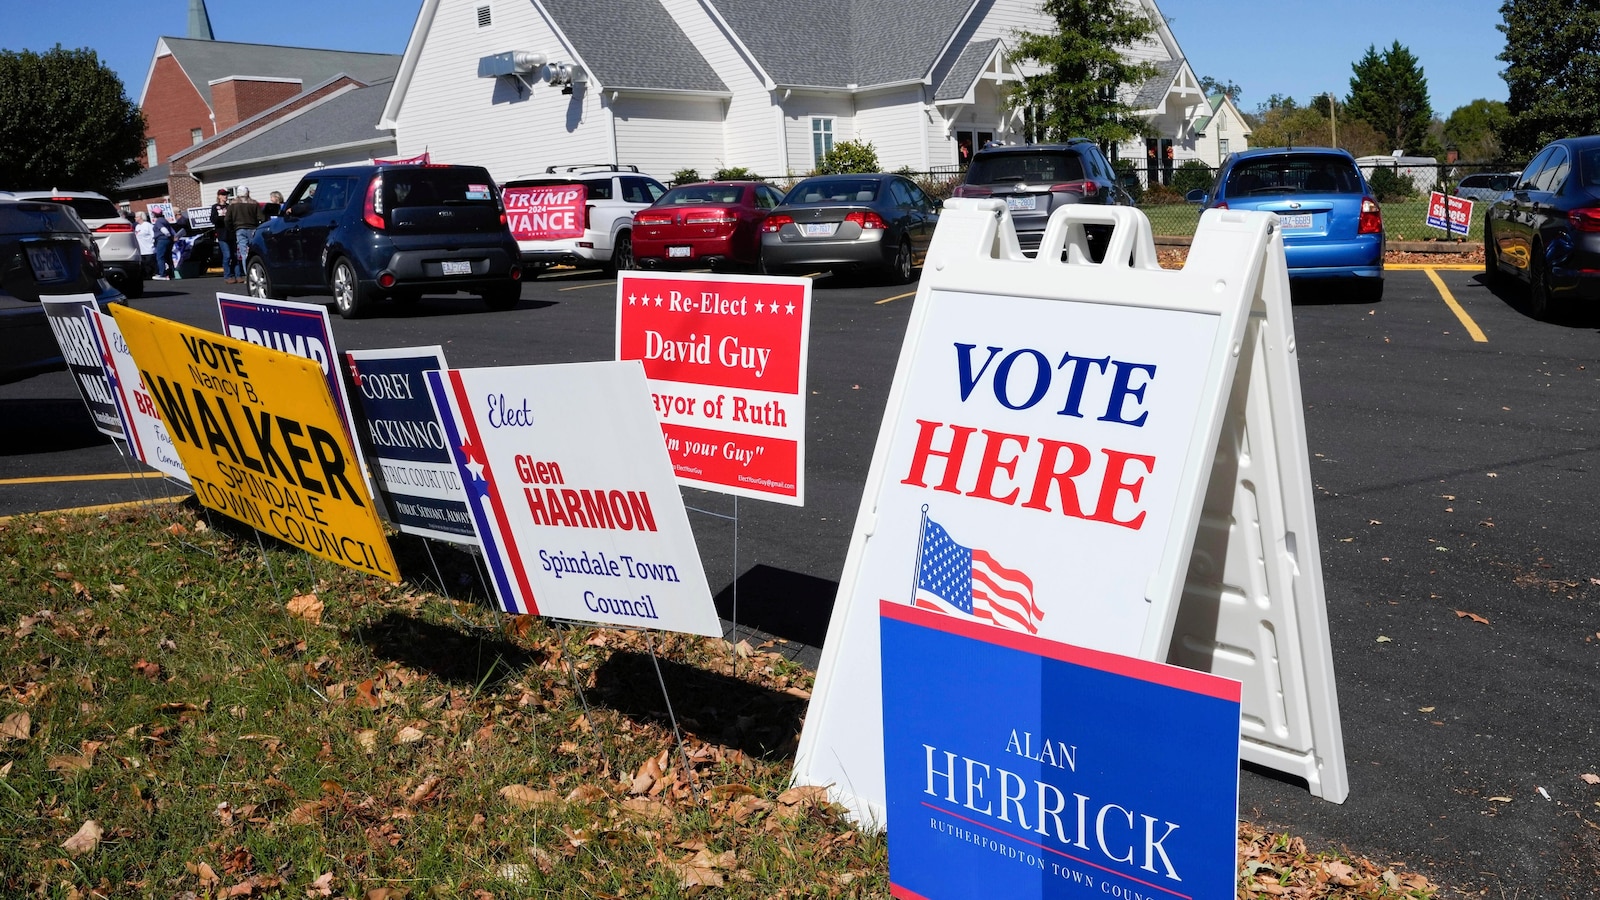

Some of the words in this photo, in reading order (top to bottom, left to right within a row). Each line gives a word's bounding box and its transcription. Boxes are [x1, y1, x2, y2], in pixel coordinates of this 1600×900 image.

[509, 190, 578, 208] TRUMP
[528, 205, 547, 214] 2024
[1433, 204, 1466, 222] Shets
[507, 212, 575, 232] VANCE
[668, 289, 748, 316] Re-Elect
[113, 332, 131, 356] Ele
[180, 332, 249, 379] VOTE
[644, 330, 711, 365] David
[718, 335, 771, 378] Guy
[78, 373, 115, 404] WAL
[188, 363, 240, 403] Nancy
[243, 381, 265, 406] B.
[359, 373, 414, 400] COREY
[953, 342, 1157, 428] VOTE
[133, 389, 161, 420] BR
[487, 393, 534, 428] Elect
[703, 394, 726, 420] of
[732, 396, 787, 428] Ruth
[141, 369, 365, 508] WALKER
[683, 440, 718, 457] your
[409, 467, 442, 489] COURT
[514, 454, 565, 486] Glen
[738, 474, 795, 489] ElectYourGuy@gmail.com
[900, 418, 1156, 531] HERE
[216, 459, 329, 527] SPINDALE
[395, 501, 419, 517] PUBLIC
[523, 487, 658, 532] HARMON
[191, 474, 266, 528] TOWN
[269, 508, 391, 577] COUNCIL
[538, 549, 621, 579] Spindale
[620, 555, 680, 583] Town
[583, 590, 659, 620] Council
[1005, 728, 1077, 773] ALAN
[922, 744, 1182, 882] HERRICK
[930, 818, 1046, 871] RUTHERFORDTON
[1052, 863, 1094, 888] TOWN
